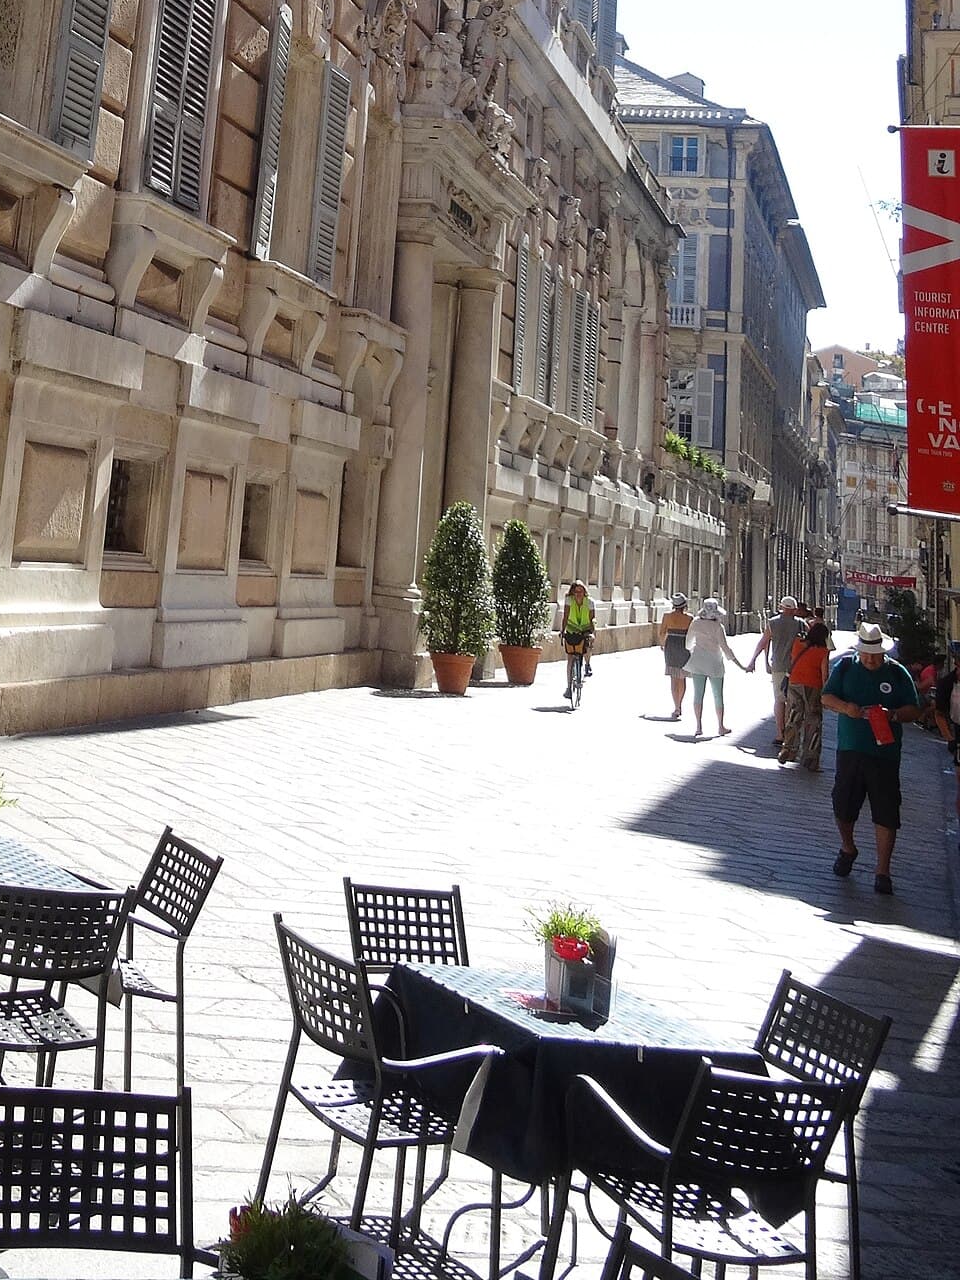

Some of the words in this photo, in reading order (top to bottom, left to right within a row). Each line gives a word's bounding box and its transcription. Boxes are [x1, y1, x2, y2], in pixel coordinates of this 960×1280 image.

[914, 291, 952, 304] TOURIST
[914, 321, 950, 334] CENTRE
[916, 398, 952, 417] GE
[938, 417, 960, 433] N
[927, 432, 960, 450] VA
